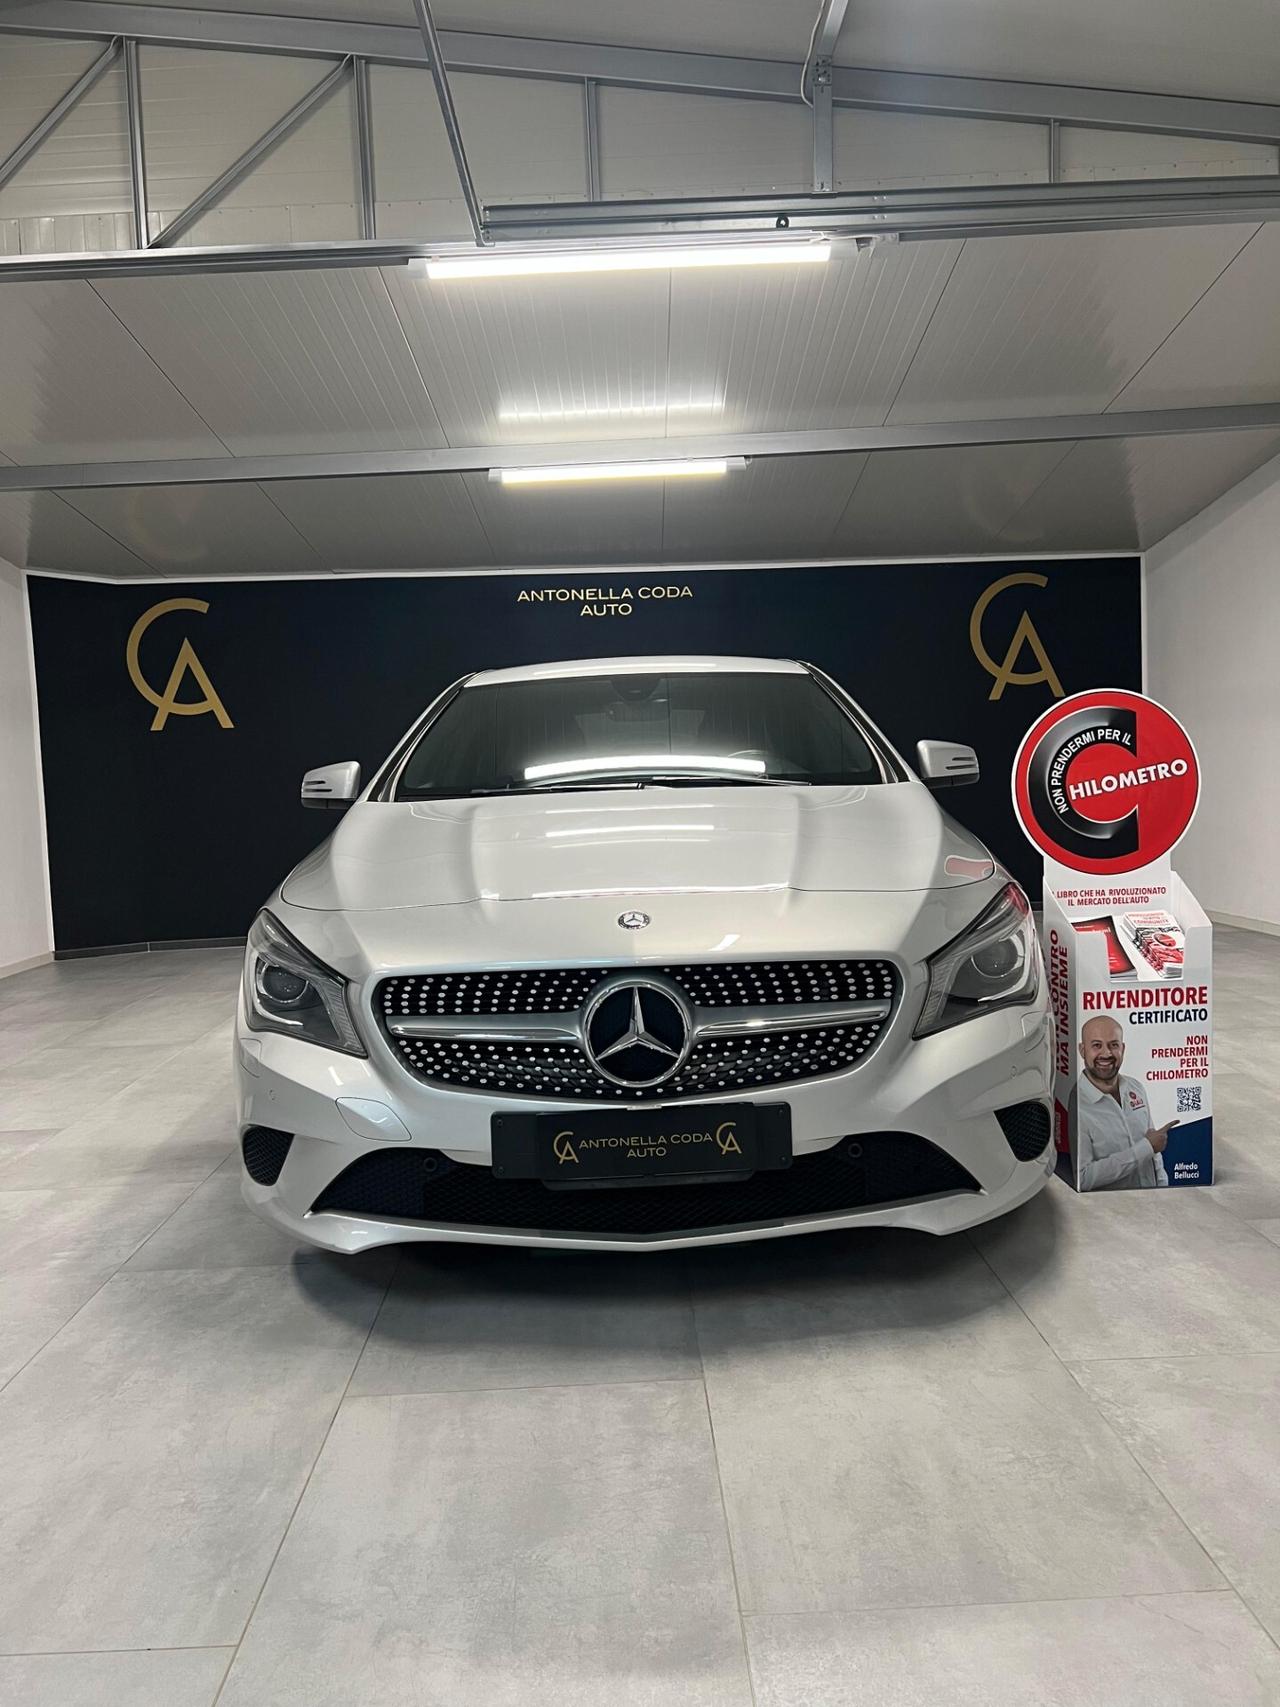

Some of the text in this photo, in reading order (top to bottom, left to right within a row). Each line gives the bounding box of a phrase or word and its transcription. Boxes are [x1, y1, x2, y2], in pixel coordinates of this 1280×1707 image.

[517, 586, 693, 602] ANTONELLA CODA
[580, 603, 633, 617] AUTO
[1051, 728, 1133, 814] NON PRENDERMI PER IL
[1057, 886, 1167, 899] LIBRO CHE HA RIVOLUZIONATO
[1067, 895, 1150, 907] IL MERCATO DELL'AUTO
[1050, 929, 1060, 1016] CONTRO
[1083, 986, 1208, 1010] RIVENDITORE
[1059, 946, 1069, 1077] MA INSIEME
[1129, 1008, 1208, 1025] CERTIFICATO
[1186, 1035, 1208, 1046] NON
[1151, 1046, 1208, 1059] PRENDERMI
[1180, 1057, 1209, 1068] PER IL
[1146, 1067, 1209, 1081] CHILOMETRO
[578, 1132, 714, 1150] ANTONELLA CODA
[627, 1146, 667, 1158] AUTO
[1174, 1162, 1199, 1171] Alfredo
[1174, 1170, 1200, 1179] Bellucci
